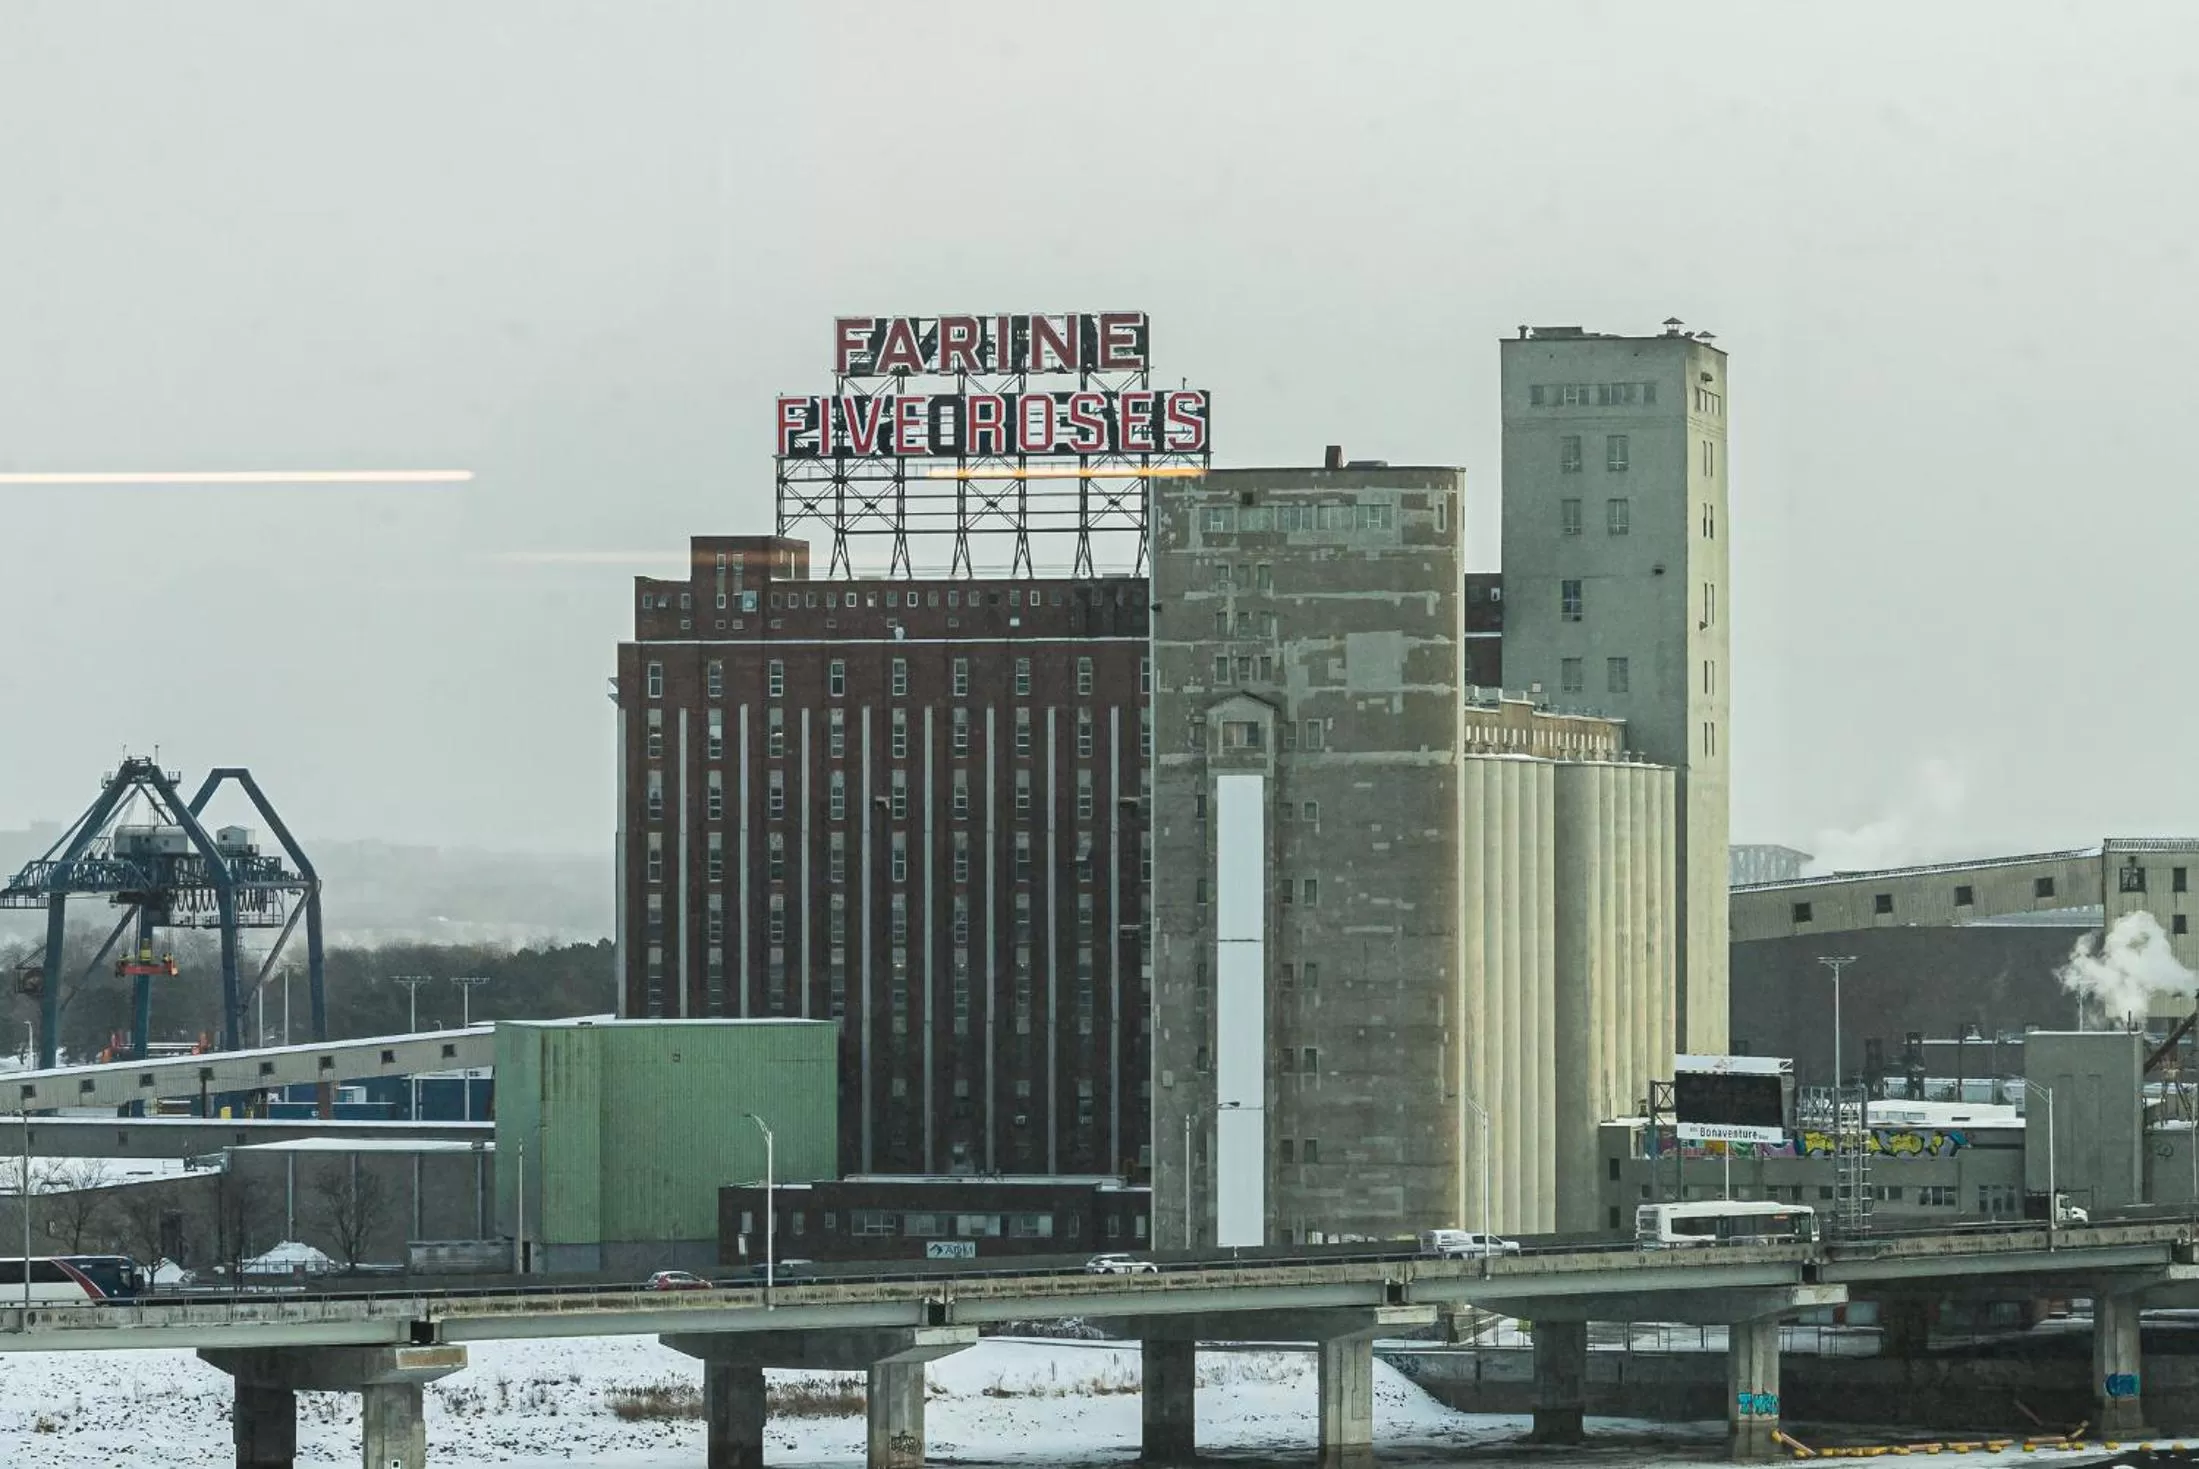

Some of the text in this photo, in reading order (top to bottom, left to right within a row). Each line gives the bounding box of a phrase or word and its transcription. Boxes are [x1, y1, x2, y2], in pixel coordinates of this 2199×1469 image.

[834, 310, 1145, 376] FARINE
[776, 391, 1206, 456] FIVE ROSES
[1700, 1126, 1758, 1140] Bonaventure
